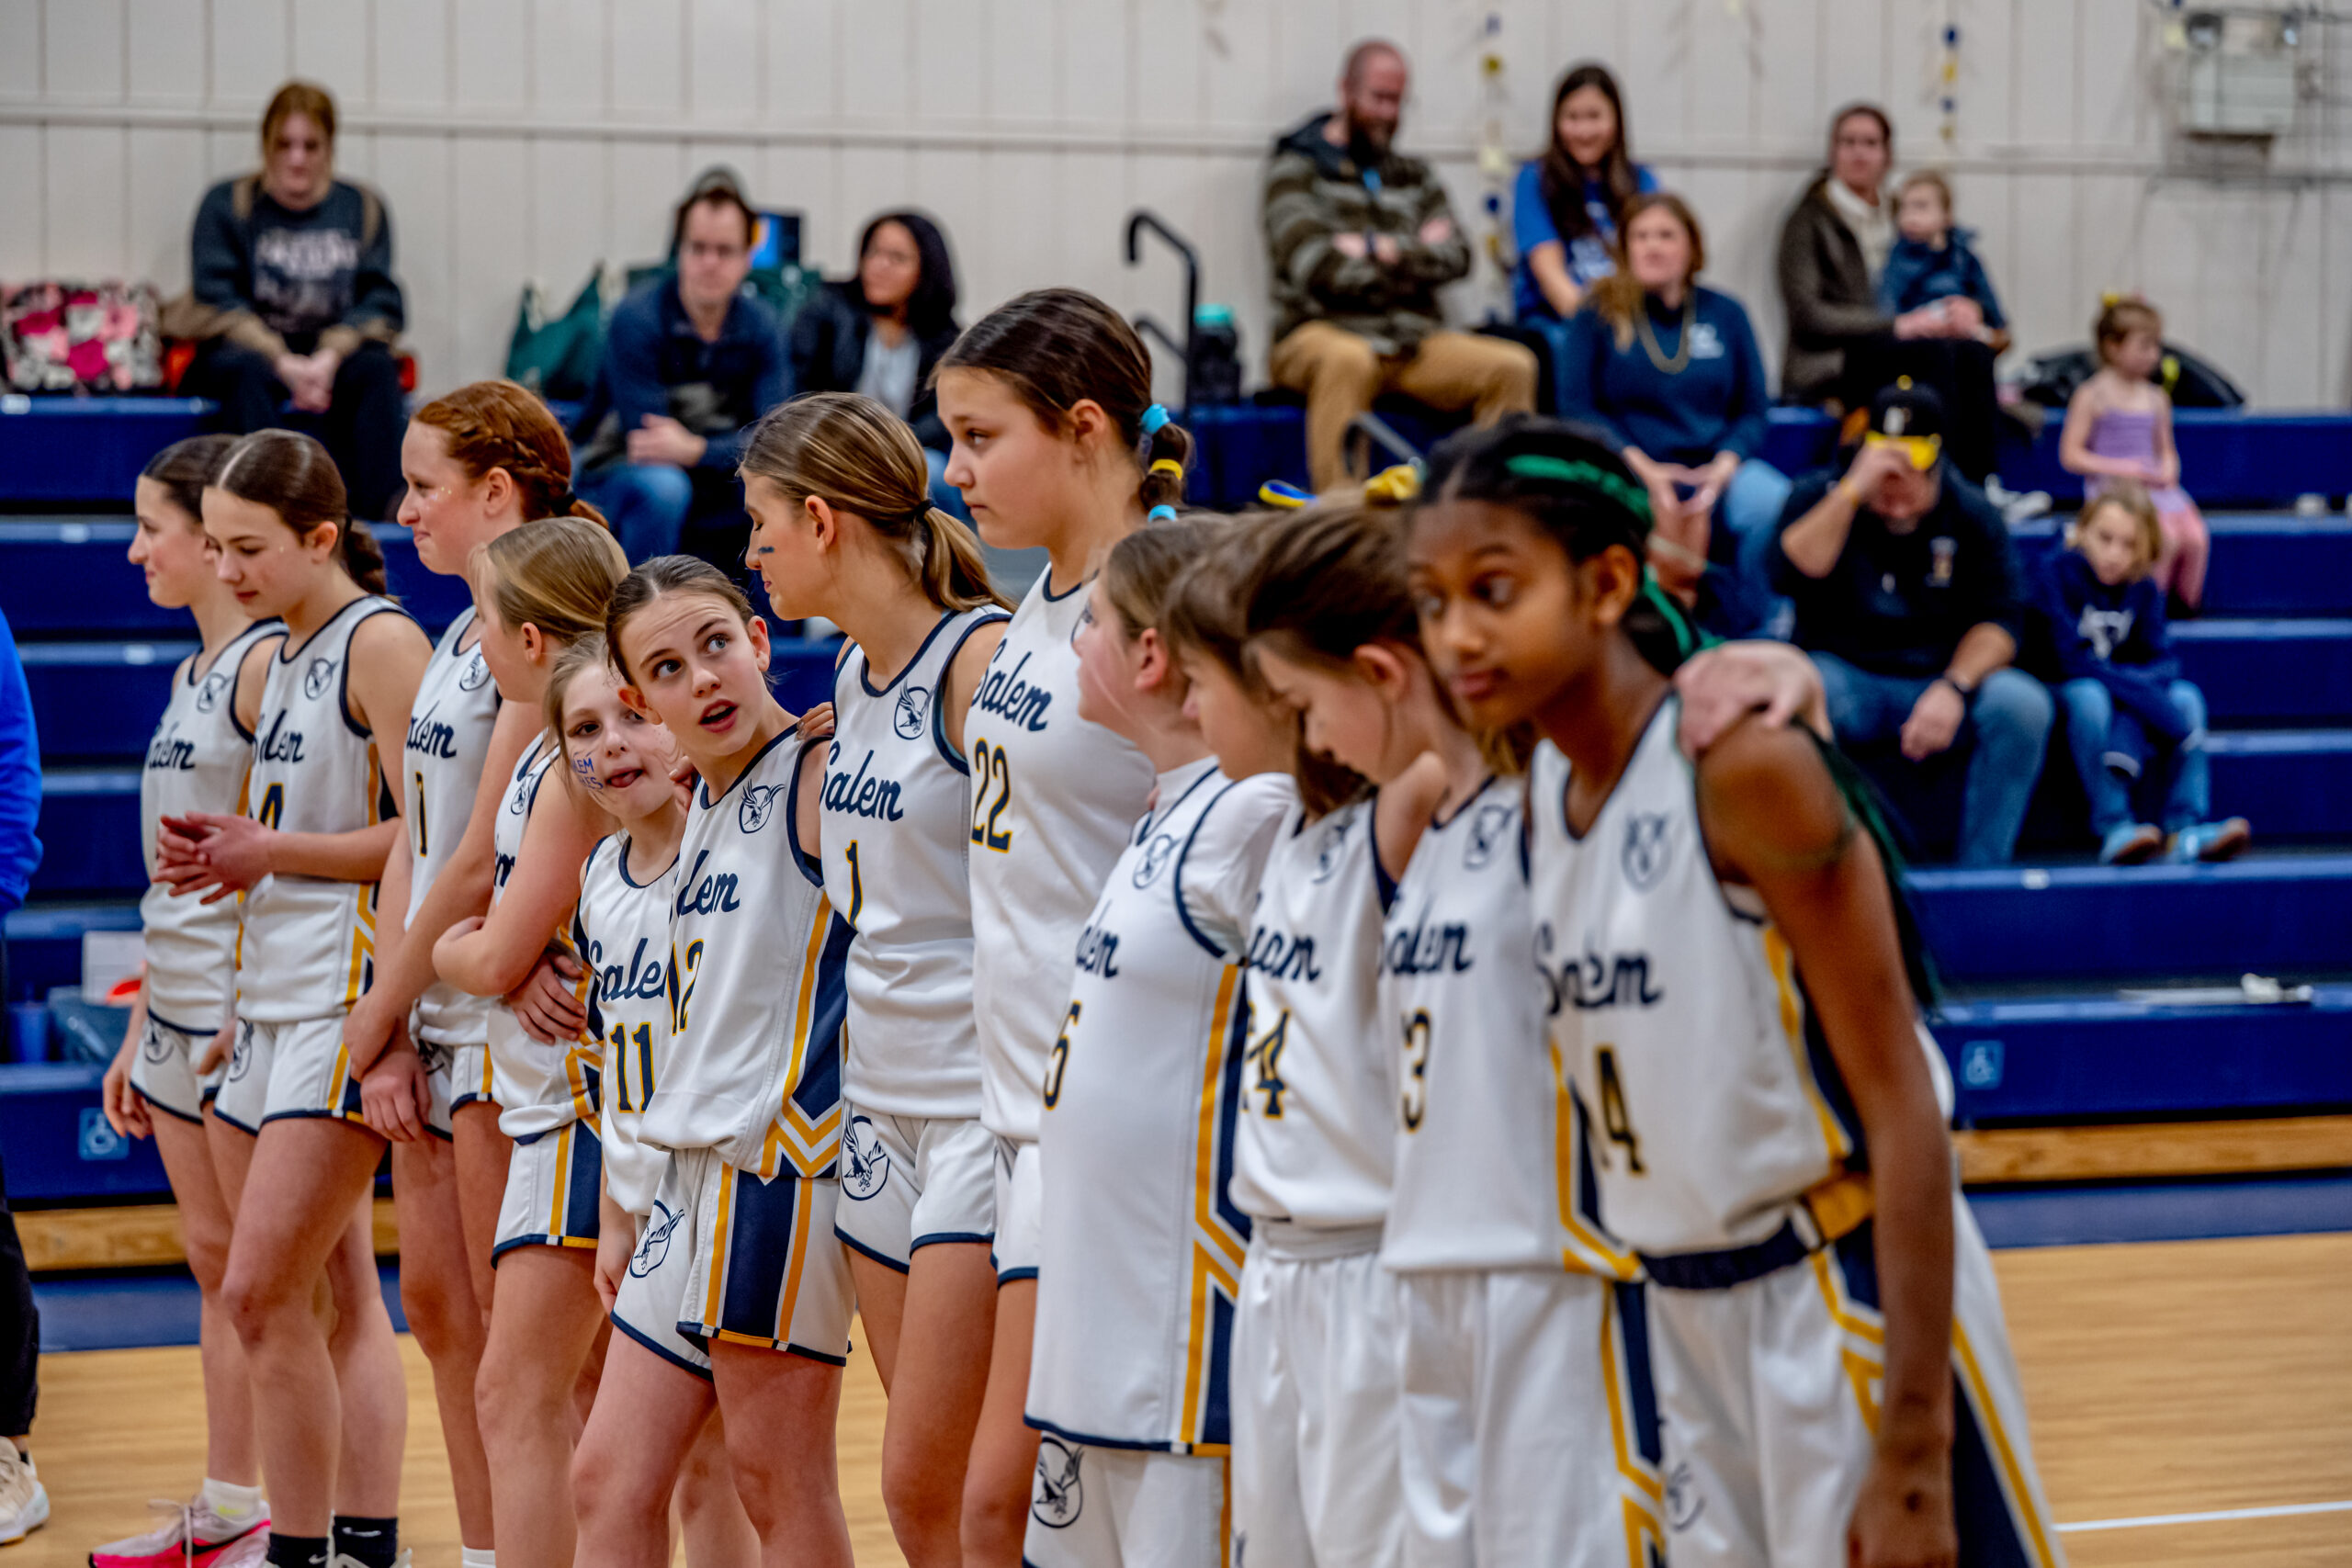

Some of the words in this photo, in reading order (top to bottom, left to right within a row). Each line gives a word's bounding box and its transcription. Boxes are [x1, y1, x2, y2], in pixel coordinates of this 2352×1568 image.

[820, 740, 904, 822] Salem
[970, 738, 1012, 853] 22
[845, 840, 863, 931] 1
[590, 938, 666, 1002] Sale
[609, 1021, 655, 1113] 11
[1400, 1007, 1432, 1134] 3
